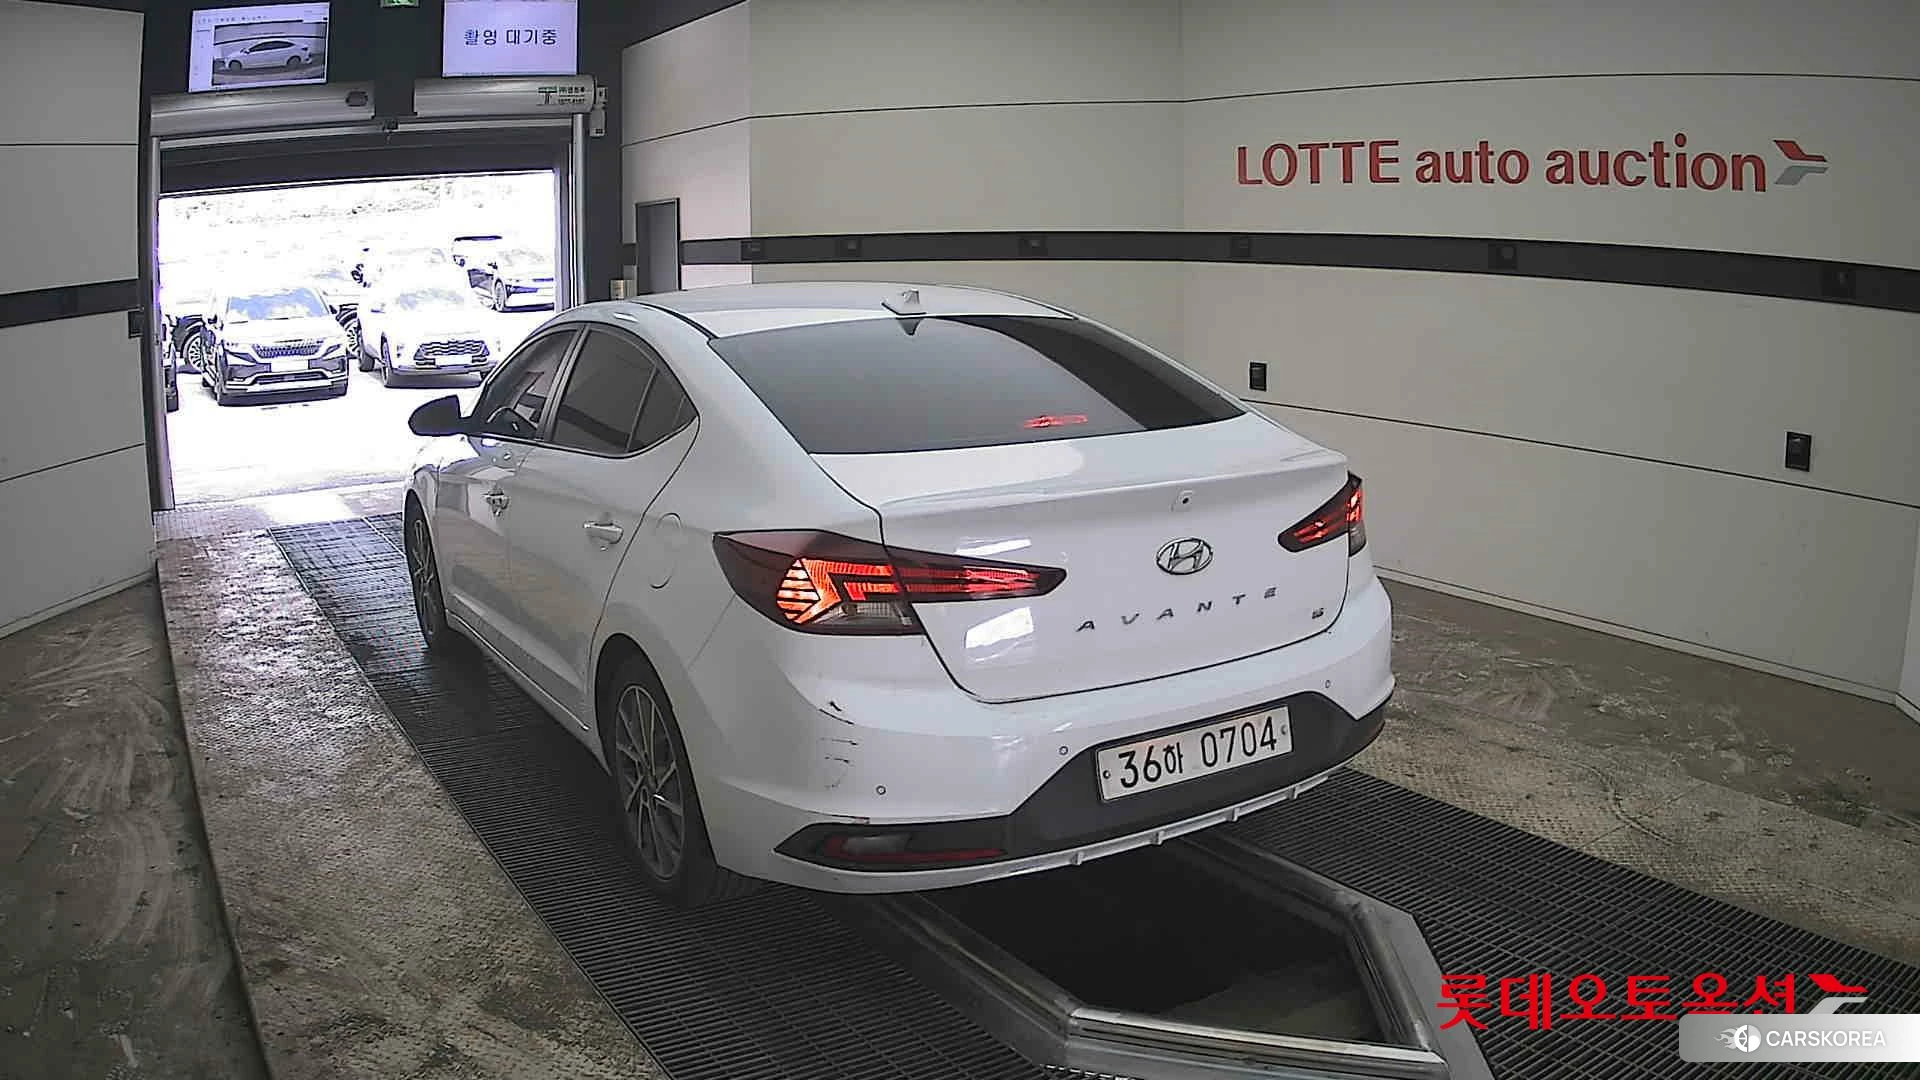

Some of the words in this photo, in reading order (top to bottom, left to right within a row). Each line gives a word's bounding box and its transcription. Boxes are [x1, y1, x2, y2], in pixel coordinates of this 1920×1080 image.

[506, 29, 558, 46] 대기중
[1237, 140, 1400, 186] LOTTE
[1415, 141, 1530, 185] auto
[1545, 132, 1767, 193] auction
[1076, 586, 1277, 633] AVANTE
[1118, 742, 1184, 789] 36하
[1200, 715, 1277, 768] 0704
